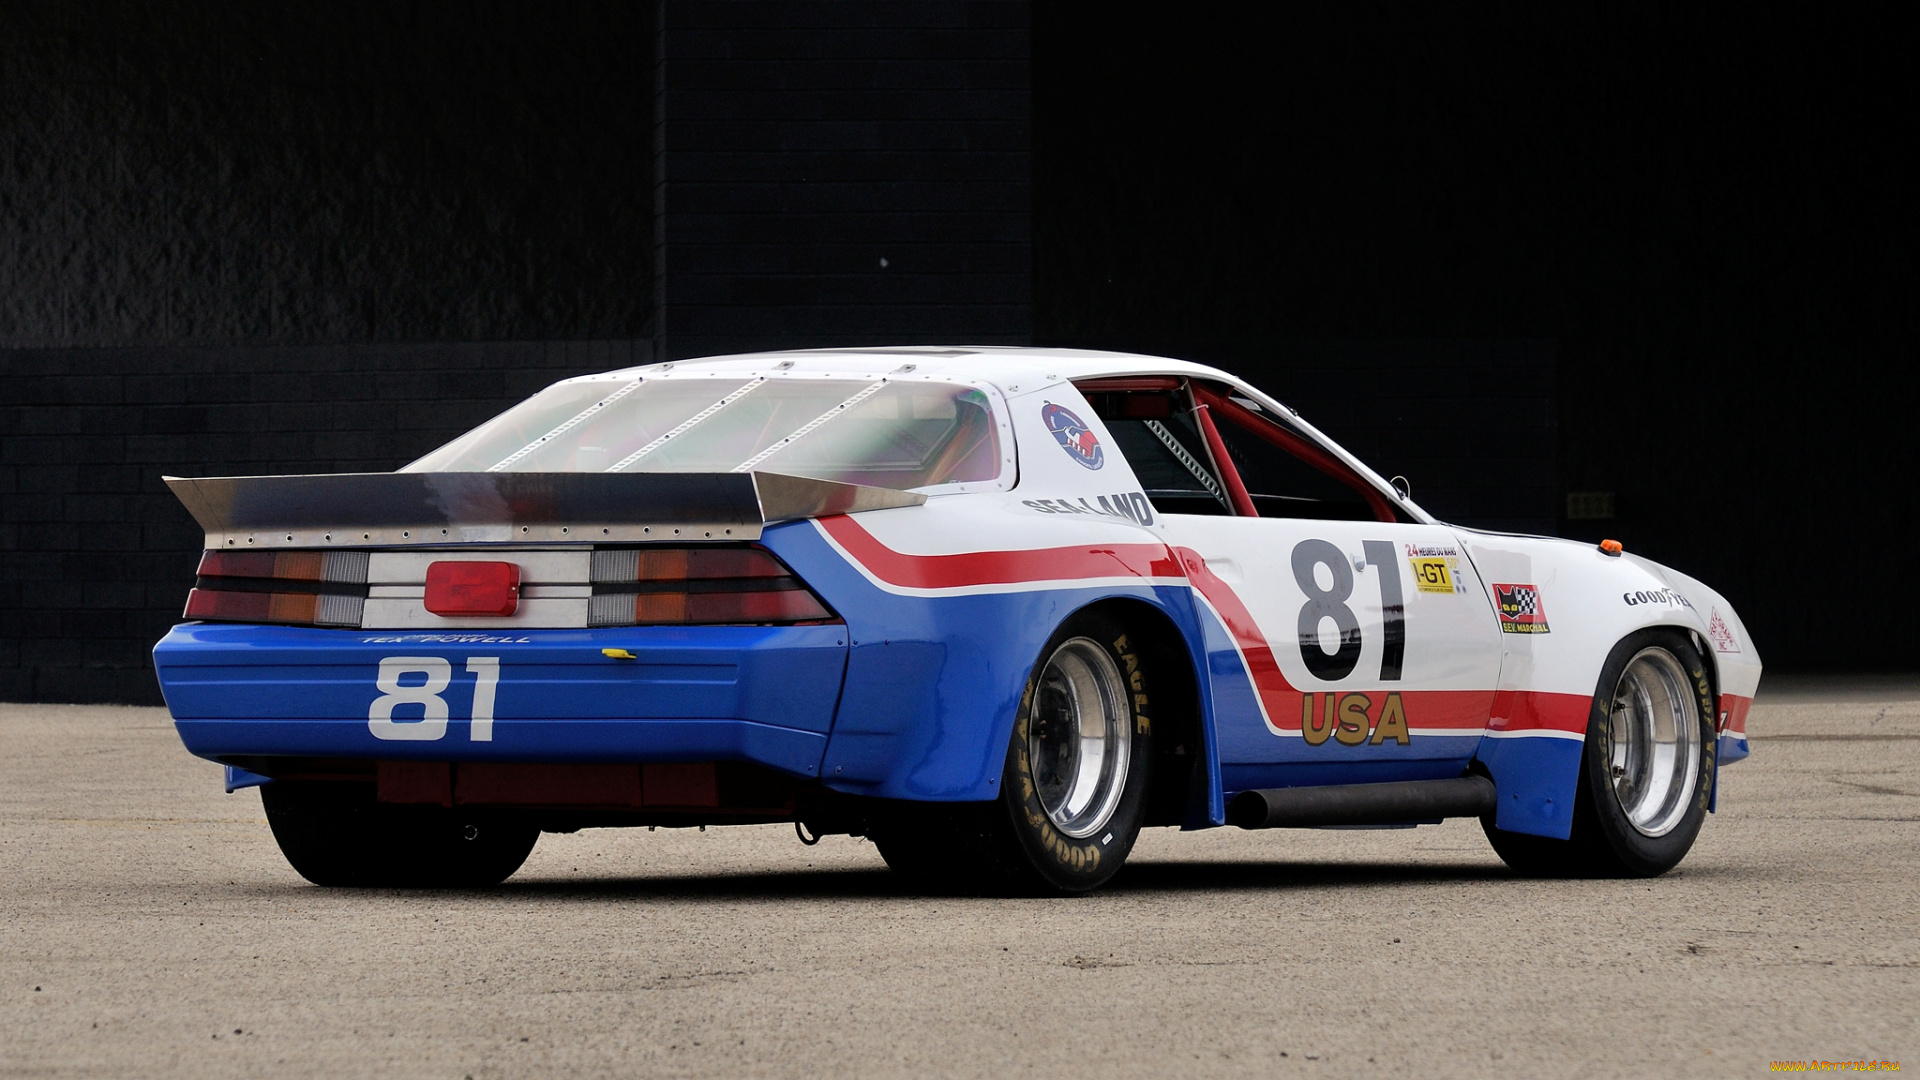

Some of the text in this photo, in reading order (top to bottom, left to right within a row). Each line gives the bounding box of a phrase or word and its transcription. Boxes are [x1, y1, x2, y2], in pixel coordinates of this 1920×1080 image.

[1405, 544, 1418, 557] 24
[1291, 539, 1406, 681] 81
[368, 656, 500, 741] 81
[1113, 633, 1151, 738] EAGLE
[1302, 692, 1411, 747] USA
